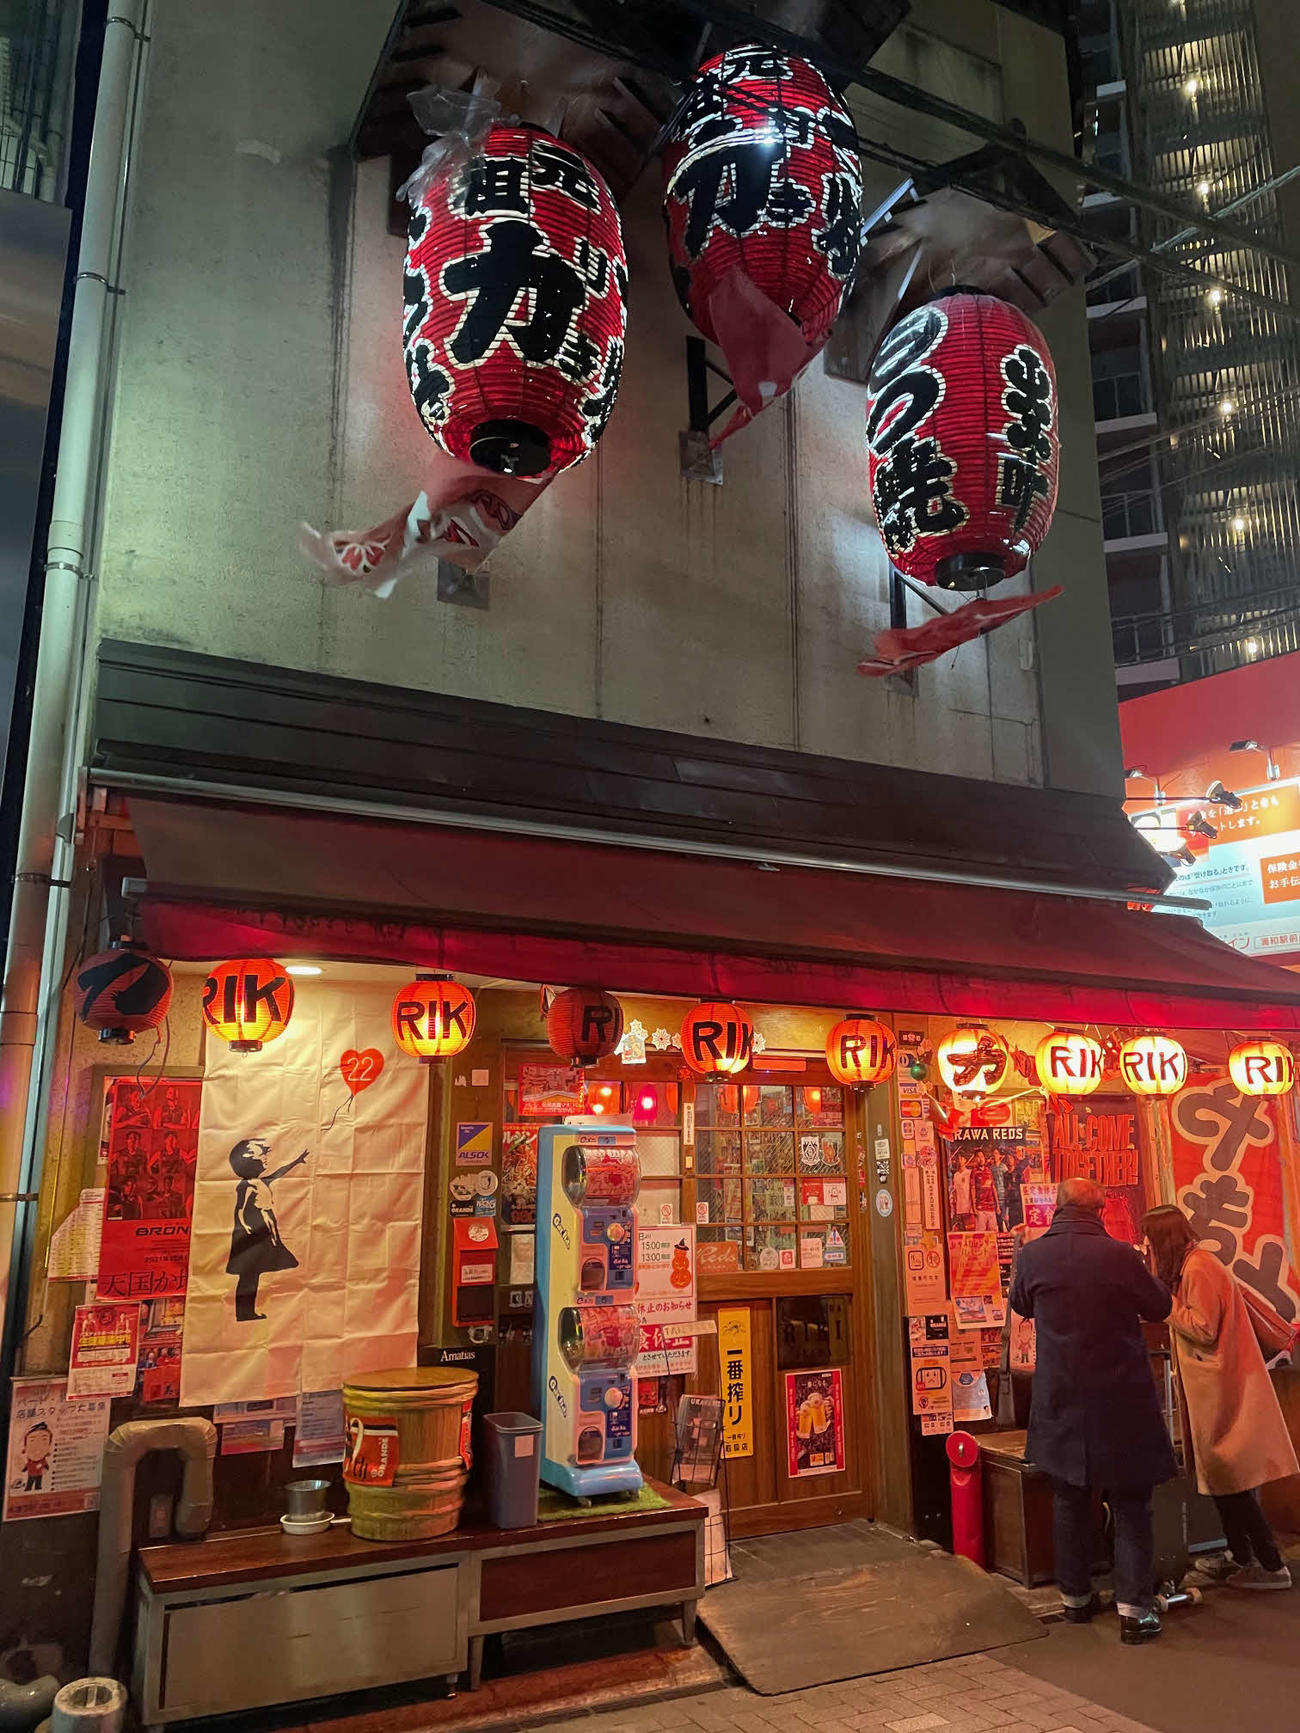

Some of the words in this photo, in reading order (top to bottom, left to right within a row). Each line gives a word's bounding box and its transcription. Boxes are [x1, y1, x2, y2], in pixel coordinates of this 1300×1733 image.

[439, 218, 588, 369] 力
[346, 1057, 374, 1082] 22
[947, 1035, 1007, 1087] 力
[992, 1127, 1023, 1140] REDS
[458, 1151, 489, 1159] ALSOK
[642, 1241, 661, 1250] 15:00
[642, 1252, 661, 1261] 13:00
[727, 1349, 744, 1425] 一番搾り
